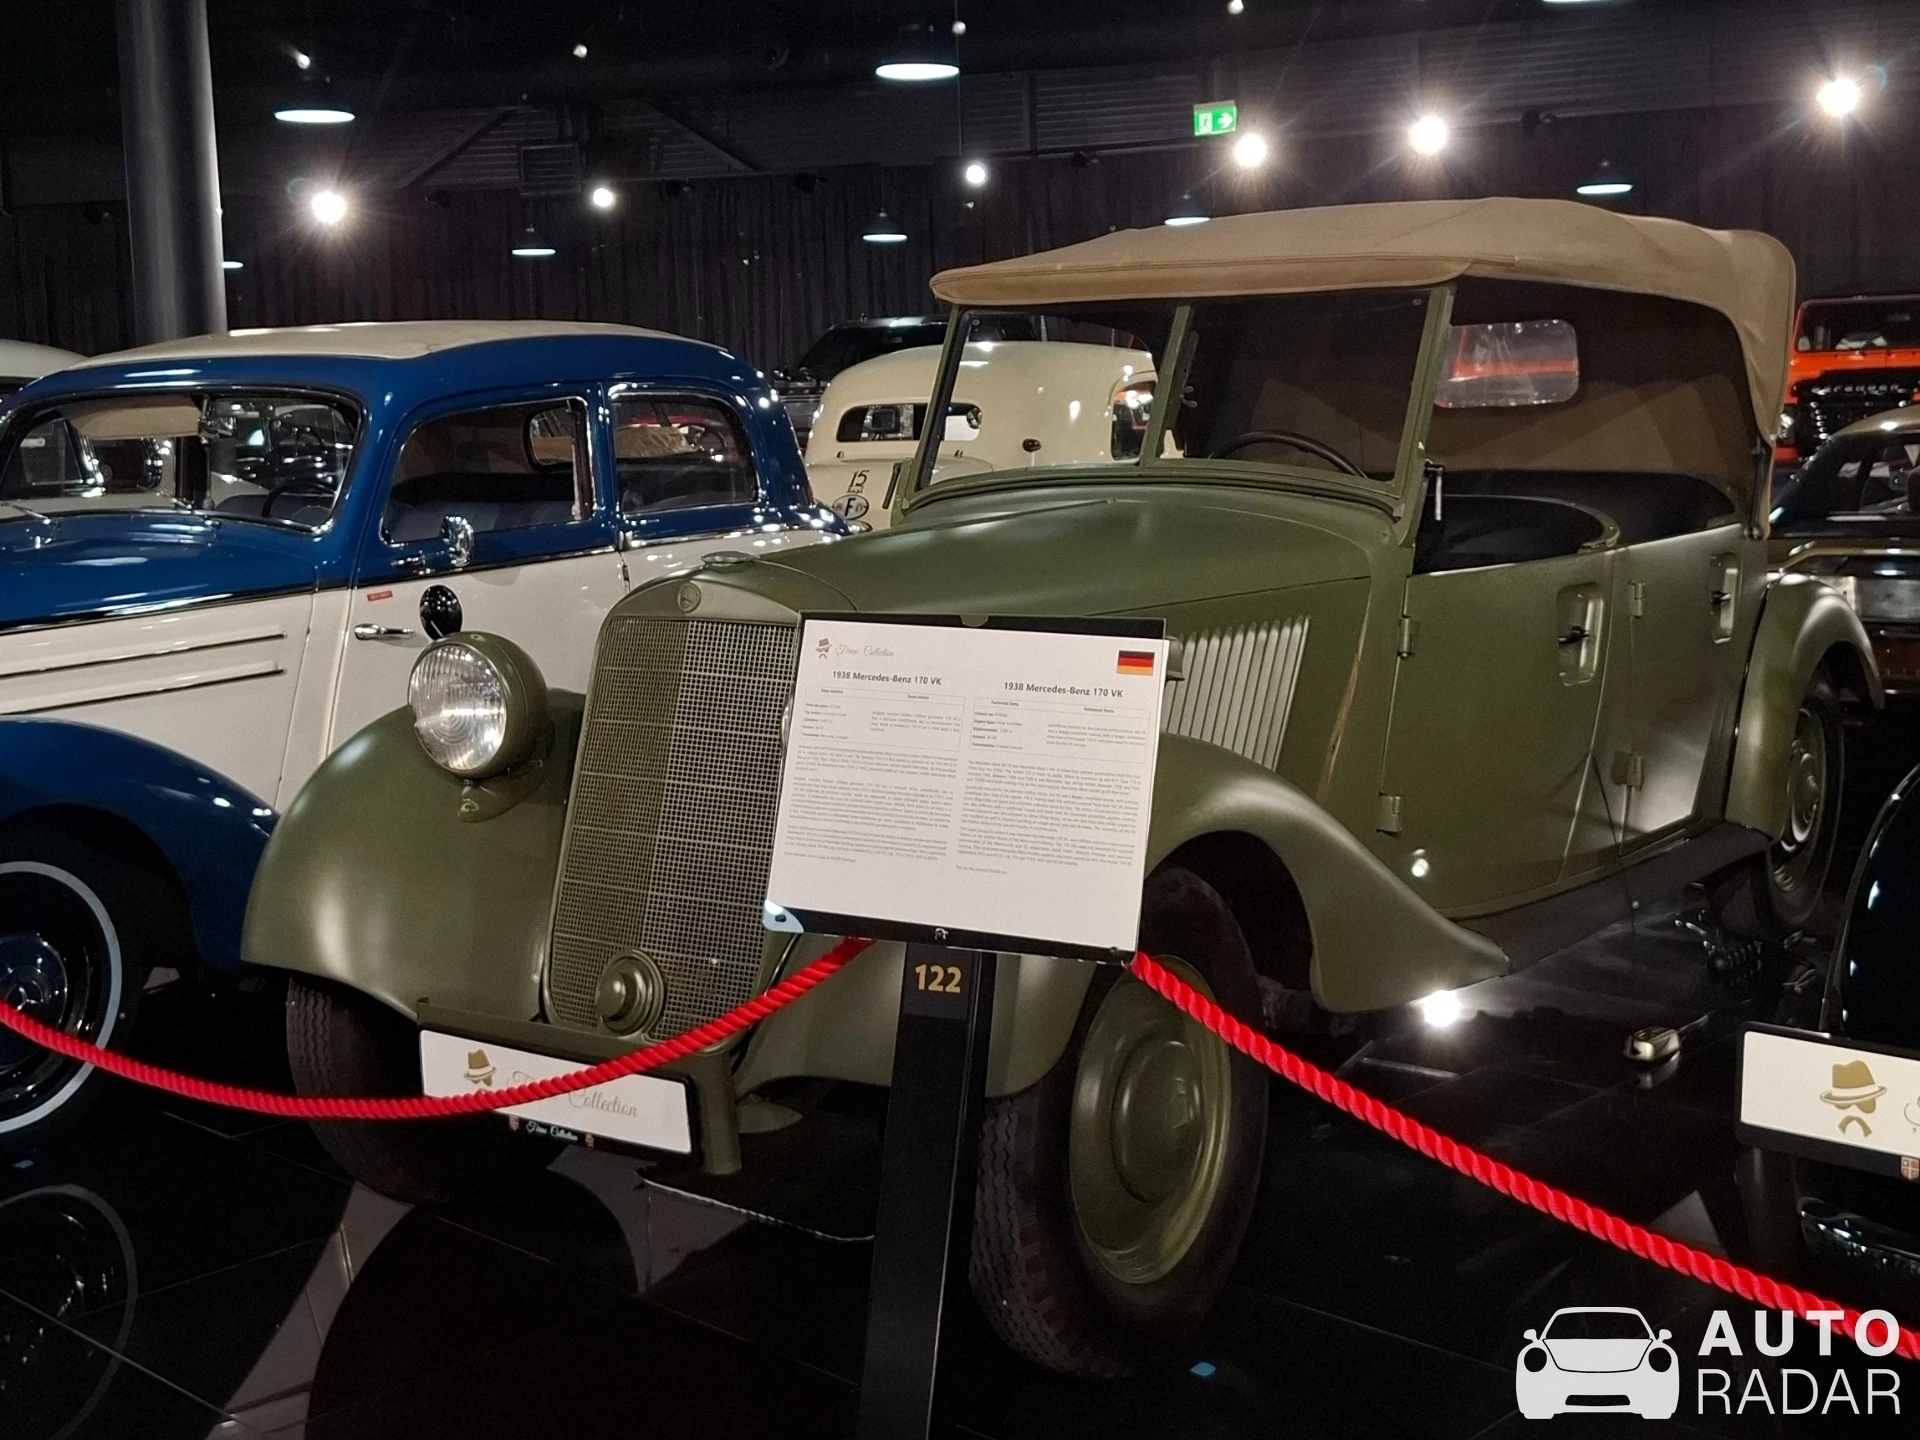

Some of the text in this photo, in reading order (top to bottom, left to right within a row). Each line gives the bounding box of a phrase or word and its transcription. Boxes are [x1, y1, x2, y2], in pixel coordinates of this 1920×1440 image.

[849, 469, 870, 488] 15
[844, 497, 856, 517] F
[833, 670, 942, 686] 1938 Mercedes-Benz 170 VK
[1004, 682, 1124, 698] 1938 Mercedes-Benz 170 VK
[915, 963, 962, 993] 122
